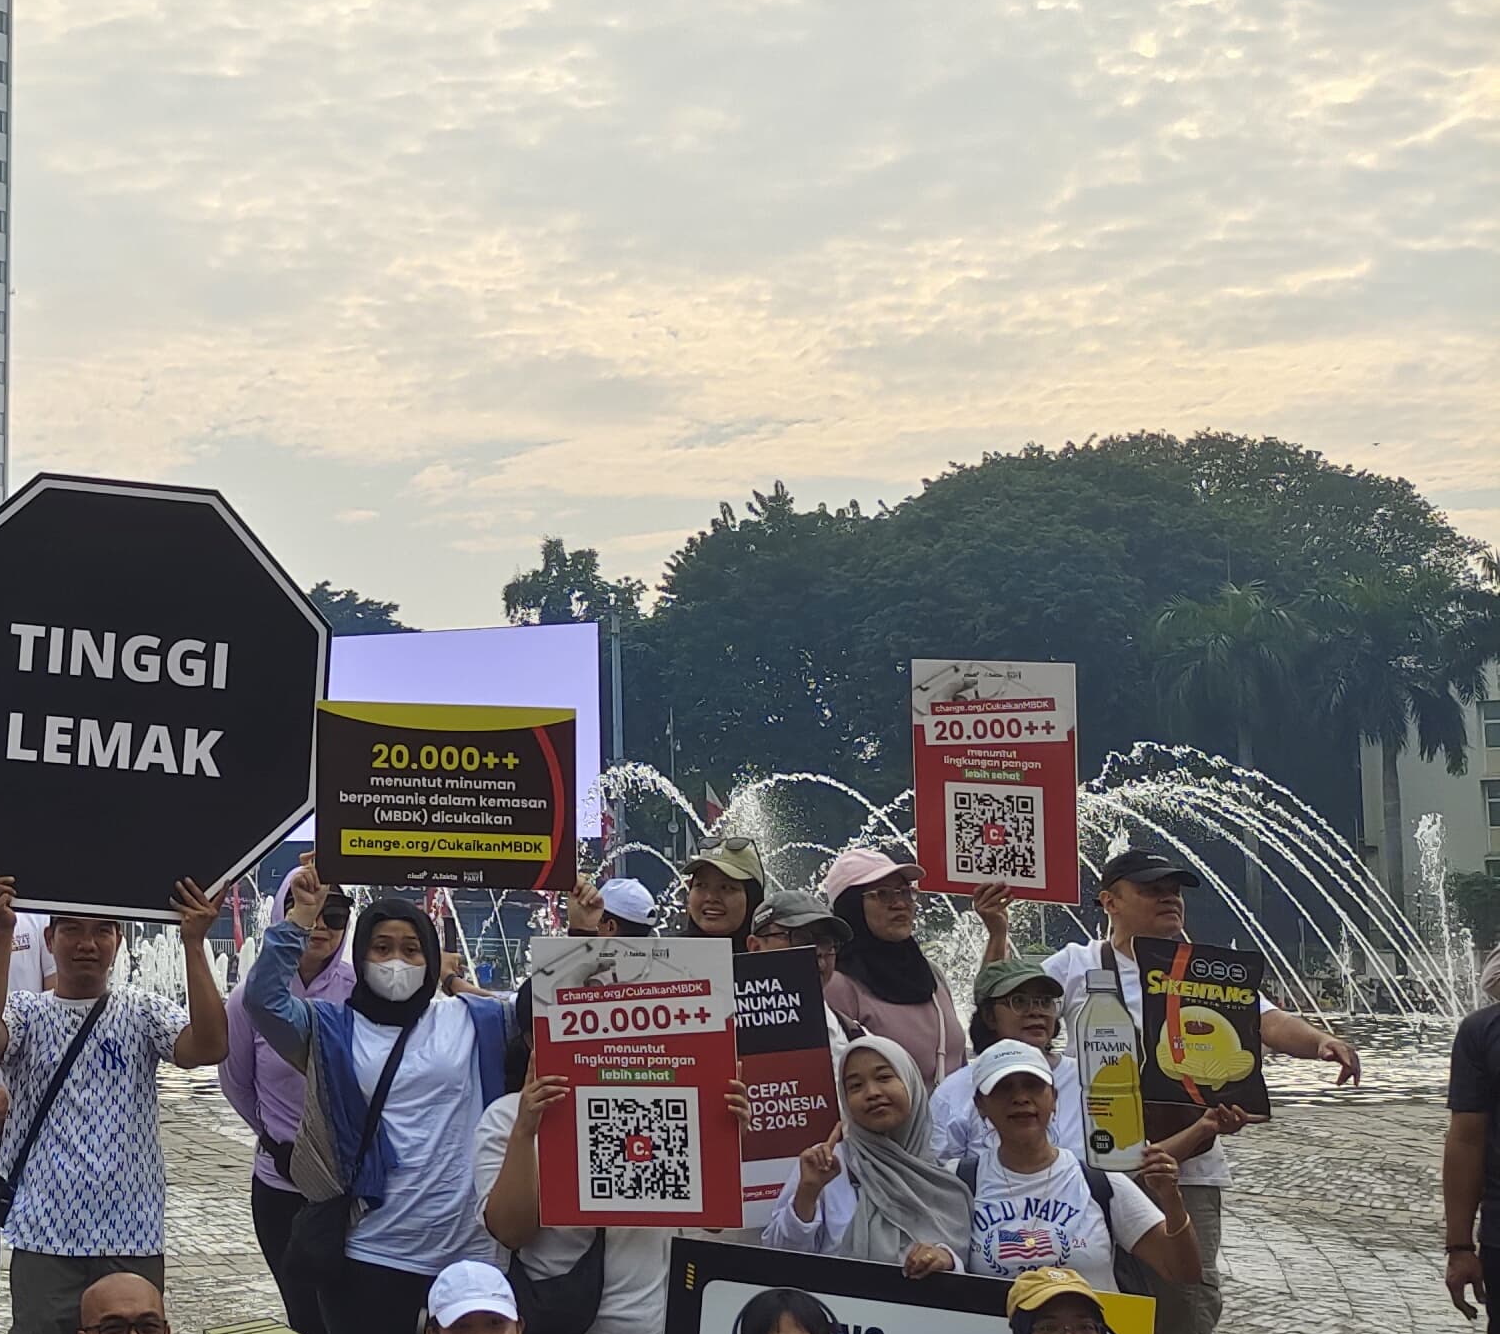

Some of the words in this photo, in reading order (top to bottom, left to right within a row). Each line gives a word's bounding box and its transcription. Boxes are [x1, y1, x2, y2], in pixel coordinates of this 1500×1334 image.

[9, 622, 229, 690] TINGGI
[934, 718, 1056, 741] 20.000++
[5, 712, 224, 778] LEMAK
[967, 749, 1017, 758] menuntut
[371, 744, 520, 771] 20.000++
[944, 755, 1000, 769] lingkungan
[1001, 760, 1041, 771] pangan
[370, 775, 443, 790] menuntut
[445, 777, 516, 792] minuman
[964, 769, 990, 779] lebih
[991, 770, 1021, 781] sehat
[339, 790, 426, 807] berpemanis
[429, 794, 477, 808] dalam
[479, 795, 548, 810] kemasan
[374, 808, 429, 825] (MBDK)
[431, 810, 513, 826] dicukaikan
[349, 836, 543, 854] change.org/CukaikanMBDK
[562, 983, 703, 1002] change.org/CukaikanMBDK
[734, 979, 782, 996] LAMA
[734, 993, 801, 1013] INUMAN
[561, 1004, 711, 1036] 20.000++
[603, 1044, 666, 1054] menuntut
[1083, 1040, 1132, 1053] PITAMIN
[574, 1054, 645, 1067] lingkungan
[647, 1056, 696, 1068] pangan
[1100, 1055, 1119, 1066] AIR
[601, 1070, 632, 1080] lebih
[634, 1070, 670, 1080] sehat
[748, 1080, 799, 1099] CEPAT
[749, 1095, 828, 1116] DONESIA
[766, 1113, 808, 1131] 2045
[973, 1200, 1016, 1232] OLD
[1021, 1197, 1081, 1227] NAVY
